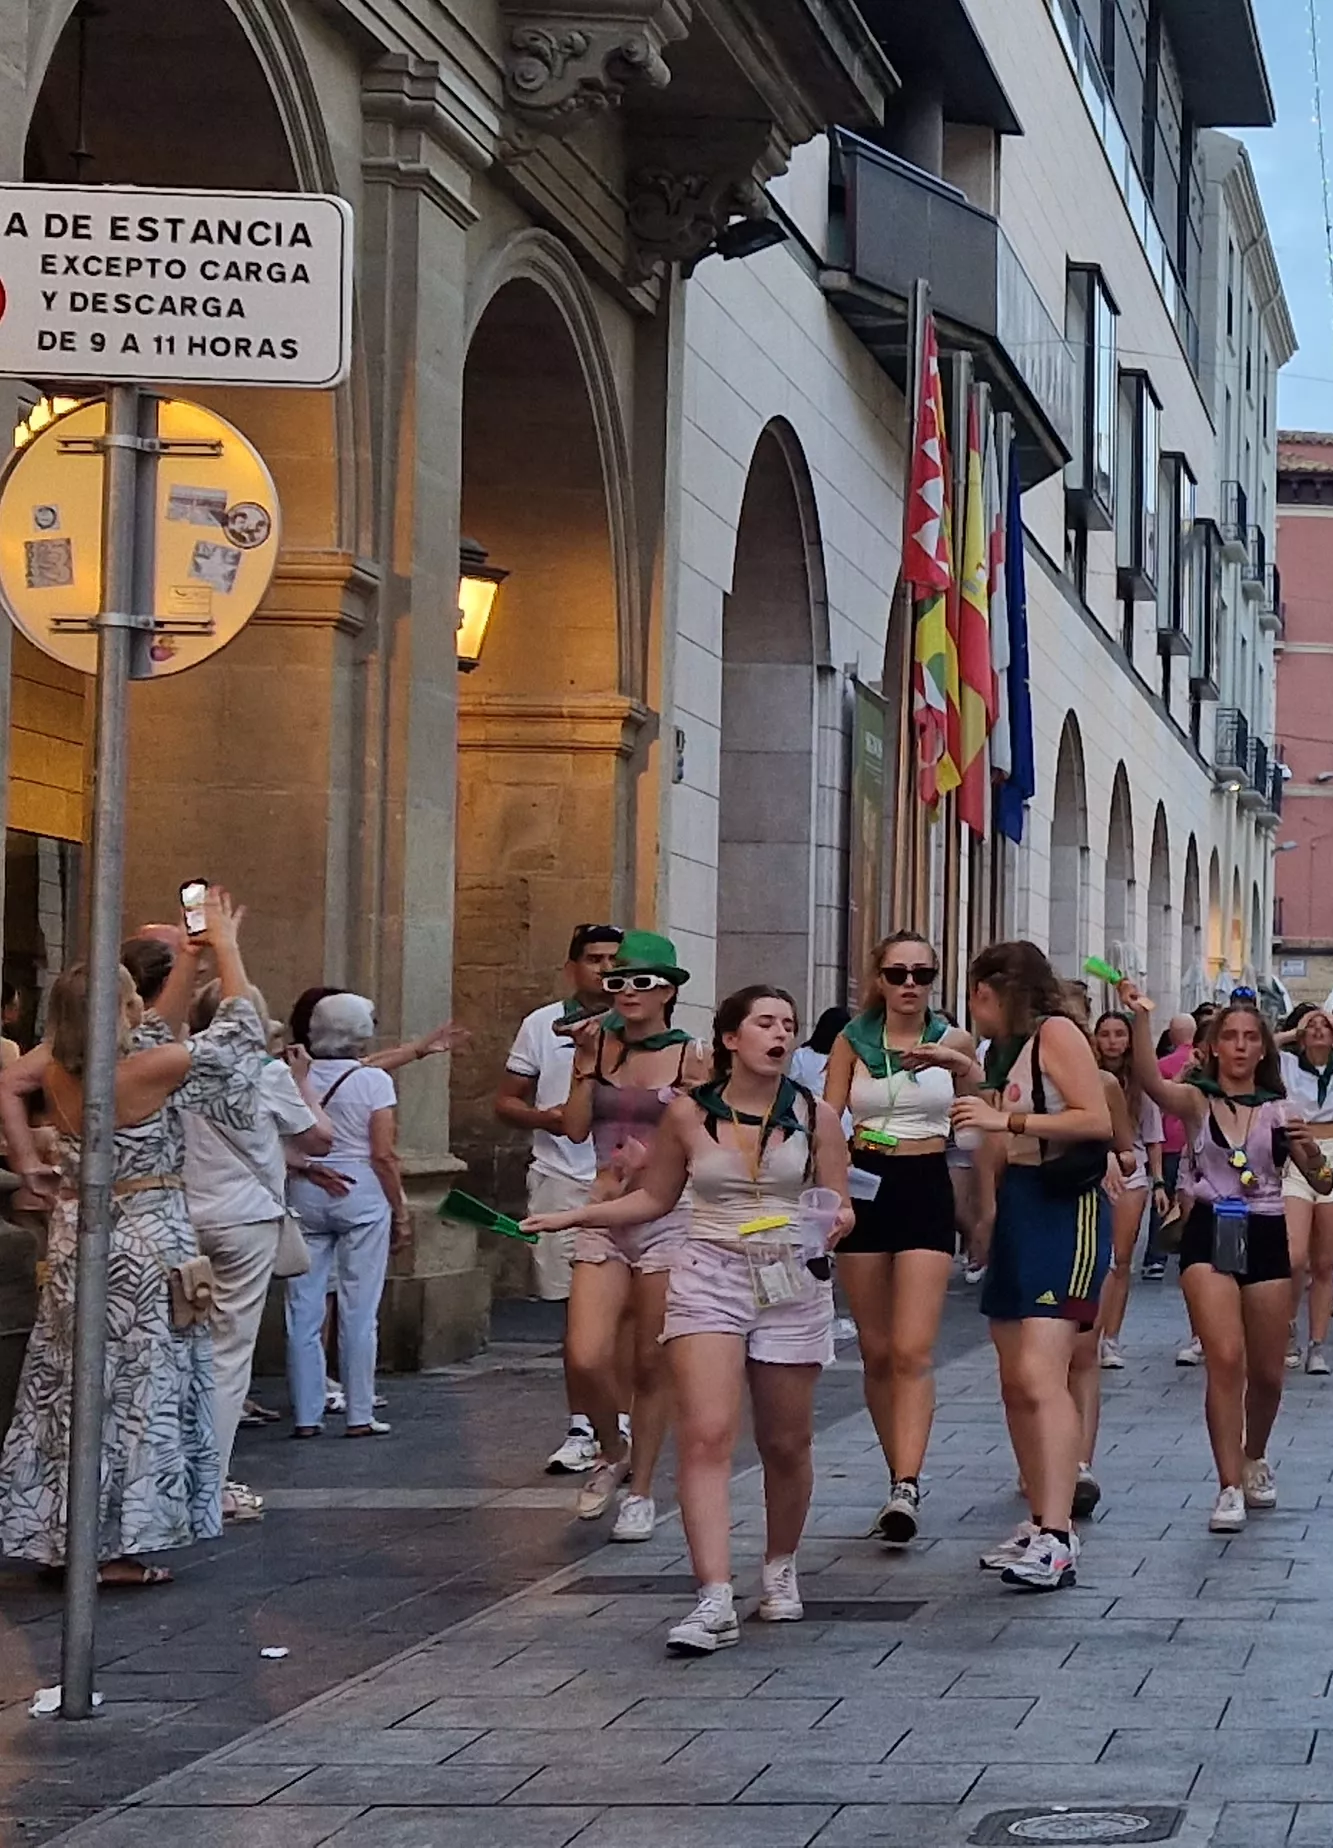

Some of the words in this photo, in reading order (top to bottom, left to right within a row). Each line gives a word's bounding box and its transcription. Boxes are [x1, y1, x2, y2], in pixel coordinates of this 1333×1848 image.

[45, 213, 92, 241] DE
[109, 216, 313, 248] ESTANCIA
[40, 253, 187, 280] EXCEPTO
[199, 259, 310, 285] CARGA
[41, 290, 58, 311] Y
[69, 291, 245, 319] DESCARGA
[37, 330, 77, 352] DE
[90, 332, 106, 353] 9
[120, 333, 140, 355] A
[153, 335, 175, 355] 11
[187, 335, 298, 360] HORAS
